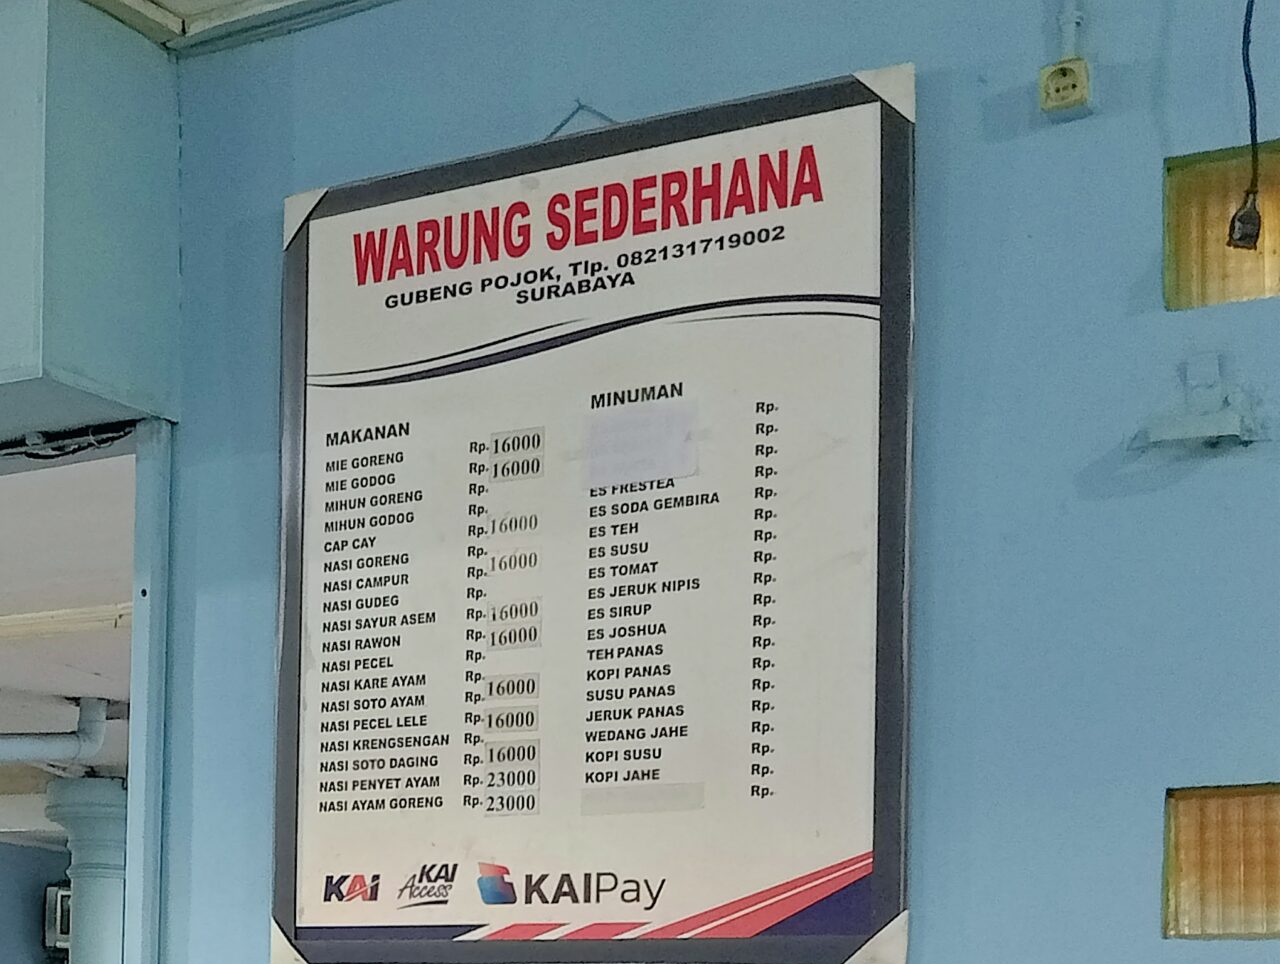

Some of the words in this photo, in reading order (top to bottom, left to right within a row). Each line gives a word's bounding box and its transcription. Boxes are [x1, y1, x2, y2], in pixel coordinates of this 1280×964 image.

[352, 201, 531, 286] WARUNG
[545, 144, 824, 253] SEDERHANA
[384, 280, 473, 309] GUBENG
[480, 268, 562, 293] POJOK,
[568, 258, 609, 278] Tlp.
[616, 225, 786, 269] 082131719002
[515, 272, 635, 305] SURABAYA
[591, 382, 683, 410] MINUMAN
[756, 402, 778, 415] Rp.
[326, 422, 410, 447] MAKANAN
[756, 423, 778, 436] Rp.
[494, 434, 540, 454] 16000
[755, 444, 778, 458] Rp.
[326, 459, 347, 472] MIE
[351, 452, 404, 469] GORENG
[493, 458, 540, 478] 16000
[755, 466, 778, 479] Rp.
[325, 479, 347, 492] MIE
[351, 473, 396, 489] GODOG
[325, 497, 366, 512] MIHUN
[370, 490, 423, 507] GORENG
[754, 486, 777, 500] Rp.
[590, 506, 607, 518] ES
[611, 500, 649, 515] SODA
[654, 492, 720, 510] GEMBIRA
[324, 517, 365, 532] MIHUN
[369, 512, 414, 527] GODOG
[754, 508, 777, 522] Rp.
[492, 515, 538, 534] 16000
[589, 526, 606, 538] ES
[610, 522, 638, 536] TEH
[324, 540, 348, 552] CAP
[352, 536, 376, 550] CAY
[754, 530, 776, 543] Rp.
[589, 546, 606, 558] ES
[610, 542, 648, 556] SUSU
[754, 551, 776, 564] Rp.
[324, 559, 352, 573] NASI
[356, 553, 409, 569] GORENG
[491, 552, 538, 571] 16000
[588, 567, 605, 579] ES
[610, 561, 658, 577] TOMAT
[323, 580, 352, 593] NASI
[356, 574, 409, 589] CAMPUR
[754, 572, 776, 586] Rp.
[588, 587, 605, 600] ES
[610, 582, 656, 597] JERUK
[662, 578, 700, 592] NIPIS
[323, 600, 352, 613] NASI
[356, 595, 399, 610] GUDEG
[753, 593, 776, 607] Rp.
[492, 602, 538, 622] 16000
[588, 608, 605, 620] ES
[610, 604, 652, 618] SIRUP
[322, 620, 351, 633] NASI
[355, 616, 396, 630] SAYUR
[400, 612, 436, 626] ASEM
[753, 615, 776, 628] Rp.
[491, 627, 537, 646] 16000
[587, 628, 604, 640] ES
[609, 623, 666, 638] JOSHUA
[322, 640, 350, 653] NASI
[355, 635, 400, 650] RAWON
[752, 636, 775, 650] Rp.
[587, 648, 614, 660] TEH
[617, 644, 663, 658] PANAS
[322, 660, 350, 673] NASI
[354, 657, 394, 670] PECEL
[586, 668, 620, 681] KOPI
[624, 664, 671, 678] PANAS
[752, 657, 775, 671] Rp.
[321, 680, 350, 693] NASI
[354, 677, 388, 690] KARE
[392, 674, 426, 687] AYAM
[489, 679, 535, 696] 16000
[752, 678, 774, 692] Rp.
[586, 688, 624, 702] SUSU
[629, 684, 676, 698] PANAS
[321, 700, 350, 713] NASI
[354, 698, 387, 710] SOTO
[390, 695, 424, 708] AYAM
[752, 700, 774, 714] Rp.
[488, 711, 534, 728] 16000
[586, 708, 632, 722] JERUK
[638, 705, 684, 719] PANAS
[320, 720, 349, 732] NASI
[353, 718, 392, 730] PECEL
[396, 715, 427, 728] LELE
[752, 721, 774, 735] Rp.
[585, 728, 646, 742] WEDANG
[650, 725, 688, 738] JAHE
[320, 740, 349, 753] NASI
[353, 734, 450, 750] KRENGSENGAN
[752, 742, 774, 756] Rp.
[490, 745, 536, 762] 16000
[585, 750, 618, 763] KOPI
[623, 748, 662, 761] SUSU
[320, 760, 348, 772] NASI
[352, 758, 386, 771] SOTO
[390, 755, 438, 769] DAGING
[751, 764, 774, 778] Rp.
[320, 780, 348, 792] NASI
[352, 778, 402, 791] PENYET
[405, 776, 440, 788] AYAM
[487, 770, 536, 788] 23000
[585, 771, 618, 783] KOPI
[623, 768, 660, 781] JAHE
[751, 785, 774, 799] Rp.
[319, 800, 348, 812] NASI
[352, 799, 385, 811] AYAM
[389, 796, 443, 809] GORENG
[486, 795, 535, 812] 23000
[419, 864, 458, 883] KAI
[323, 874, 380, 902] KAI
[397, 874, 452, 899] Access
[524, 871, 666, 910] KAIPay
